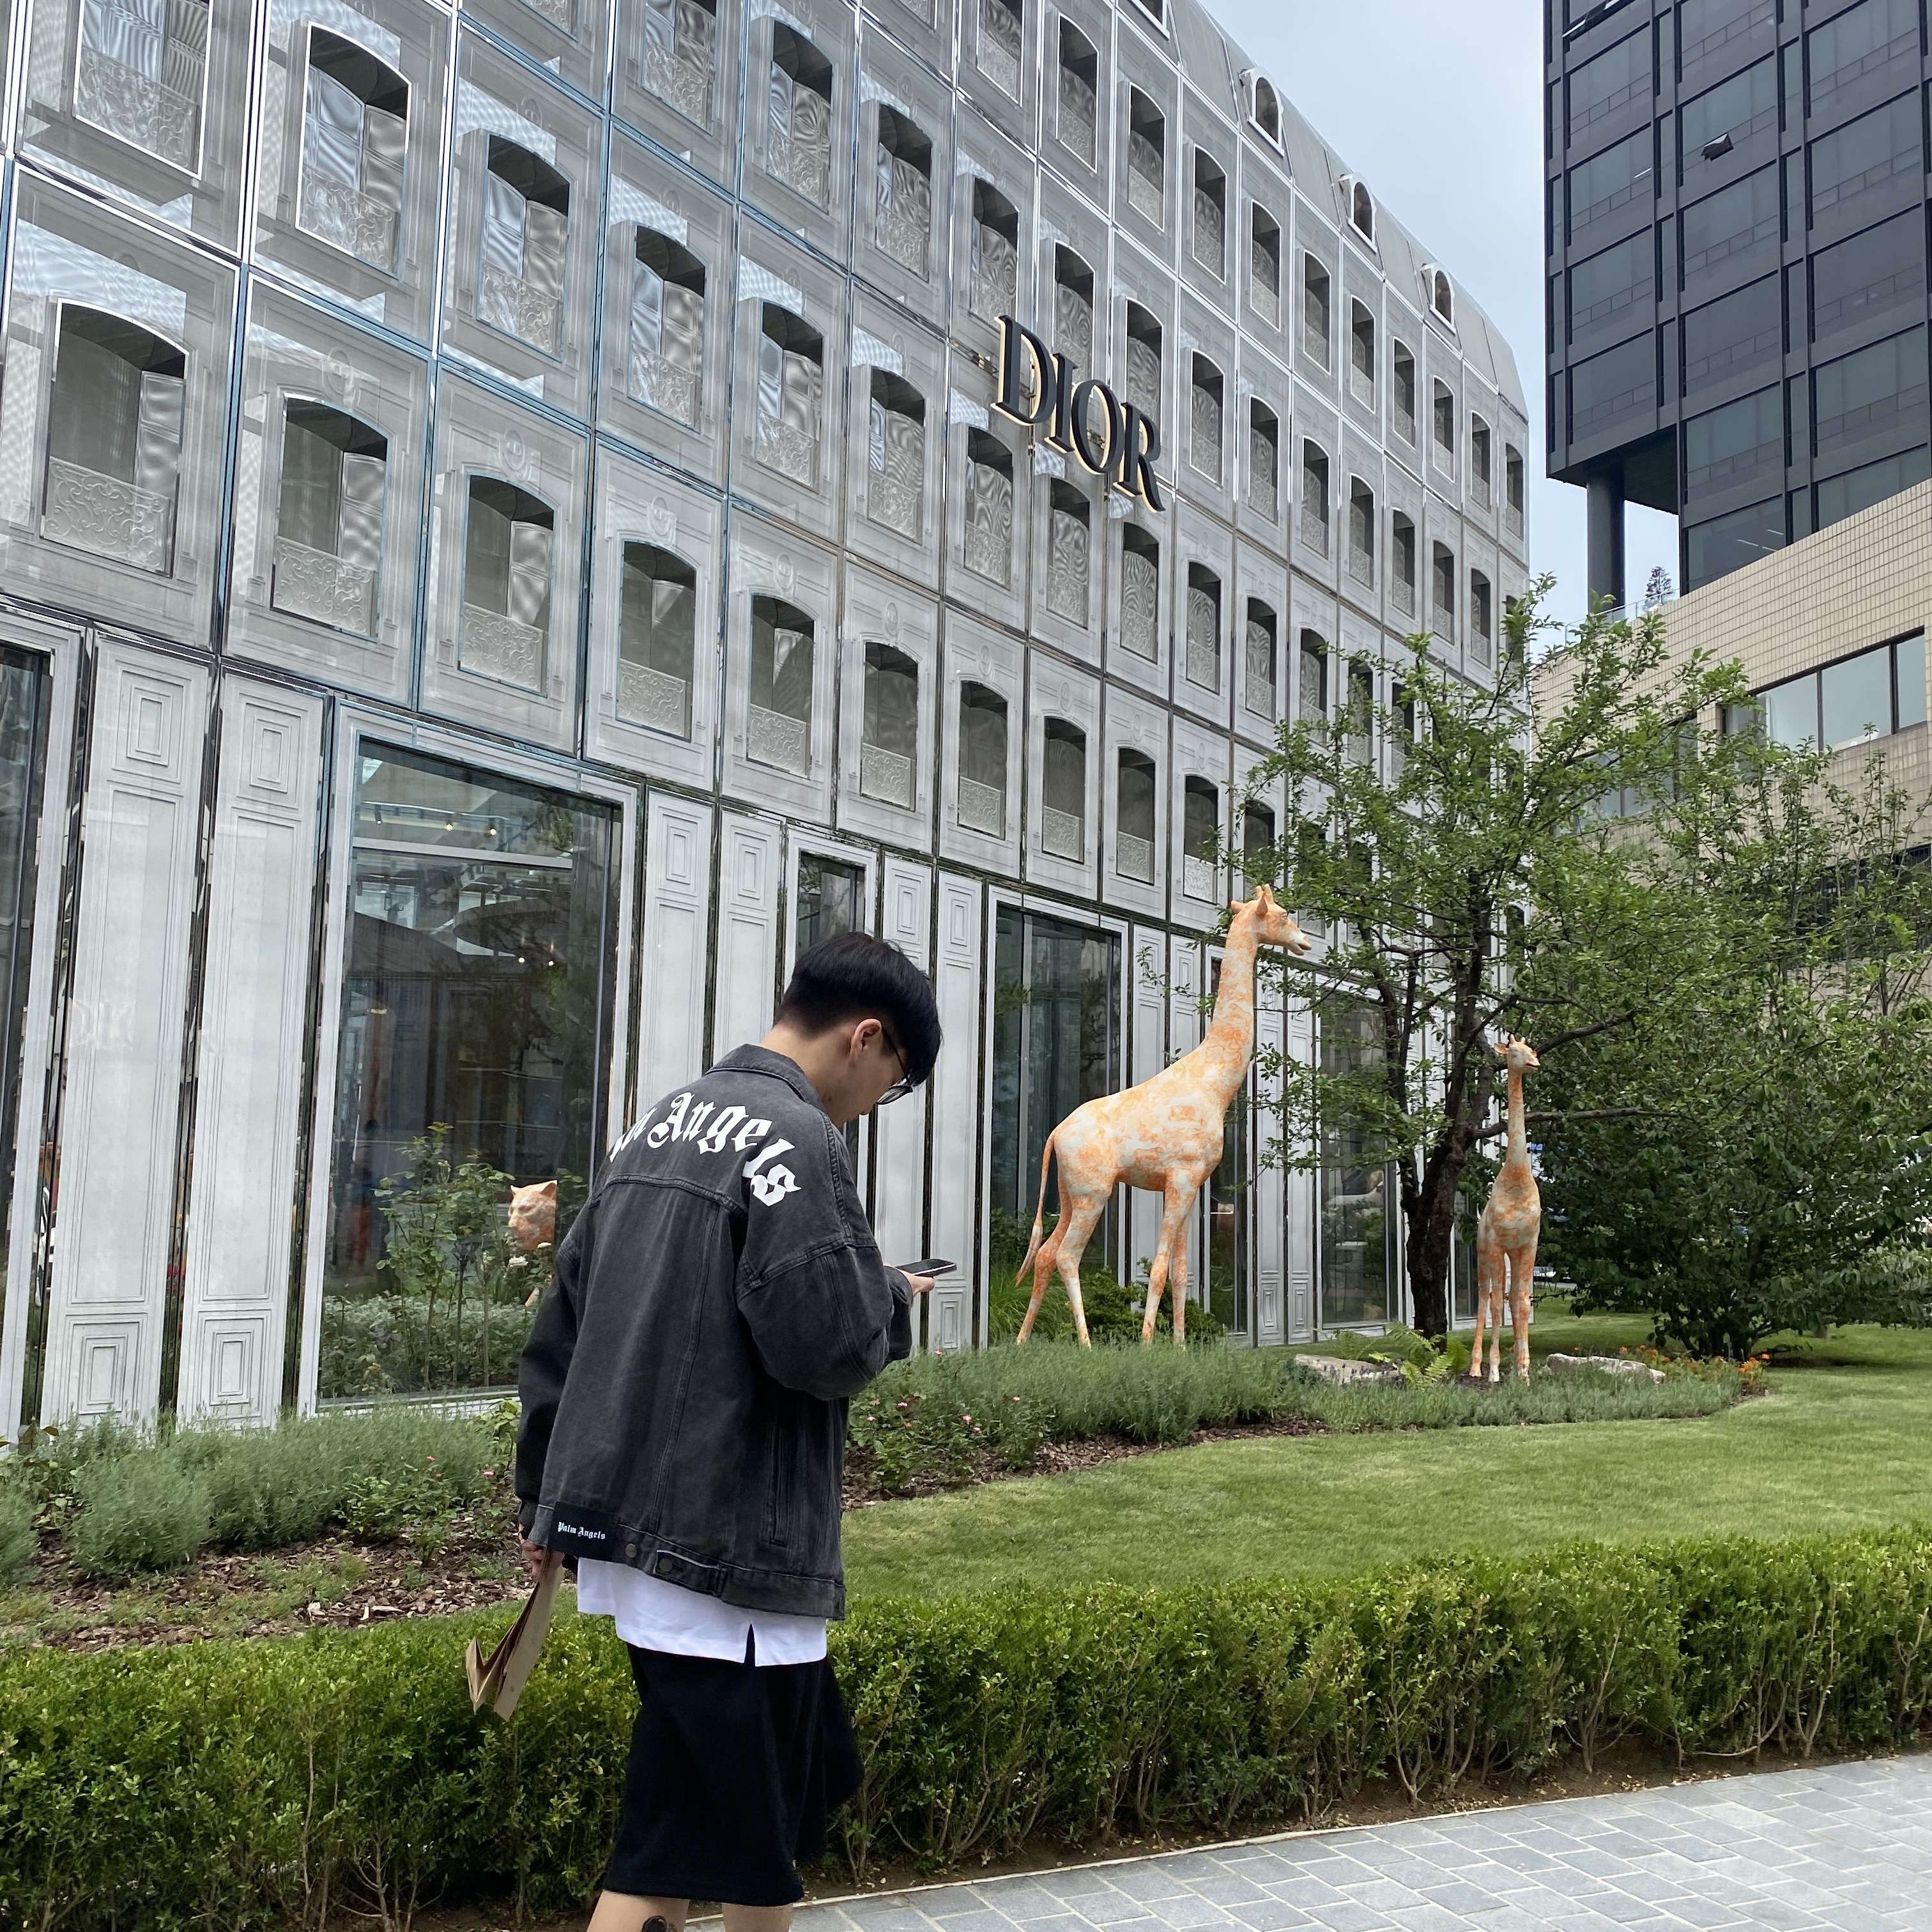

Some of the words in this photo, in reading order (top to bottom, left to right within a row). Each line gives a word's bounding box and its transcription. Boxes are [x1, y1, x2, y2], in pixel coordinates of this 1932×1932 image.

[990, 315, 1166, 513] DIOR
[647, 1091, 802, 1207] Angels
[558, 1522, 576, 1534] Palm
[578, 1526, 606, 1540] Angels
